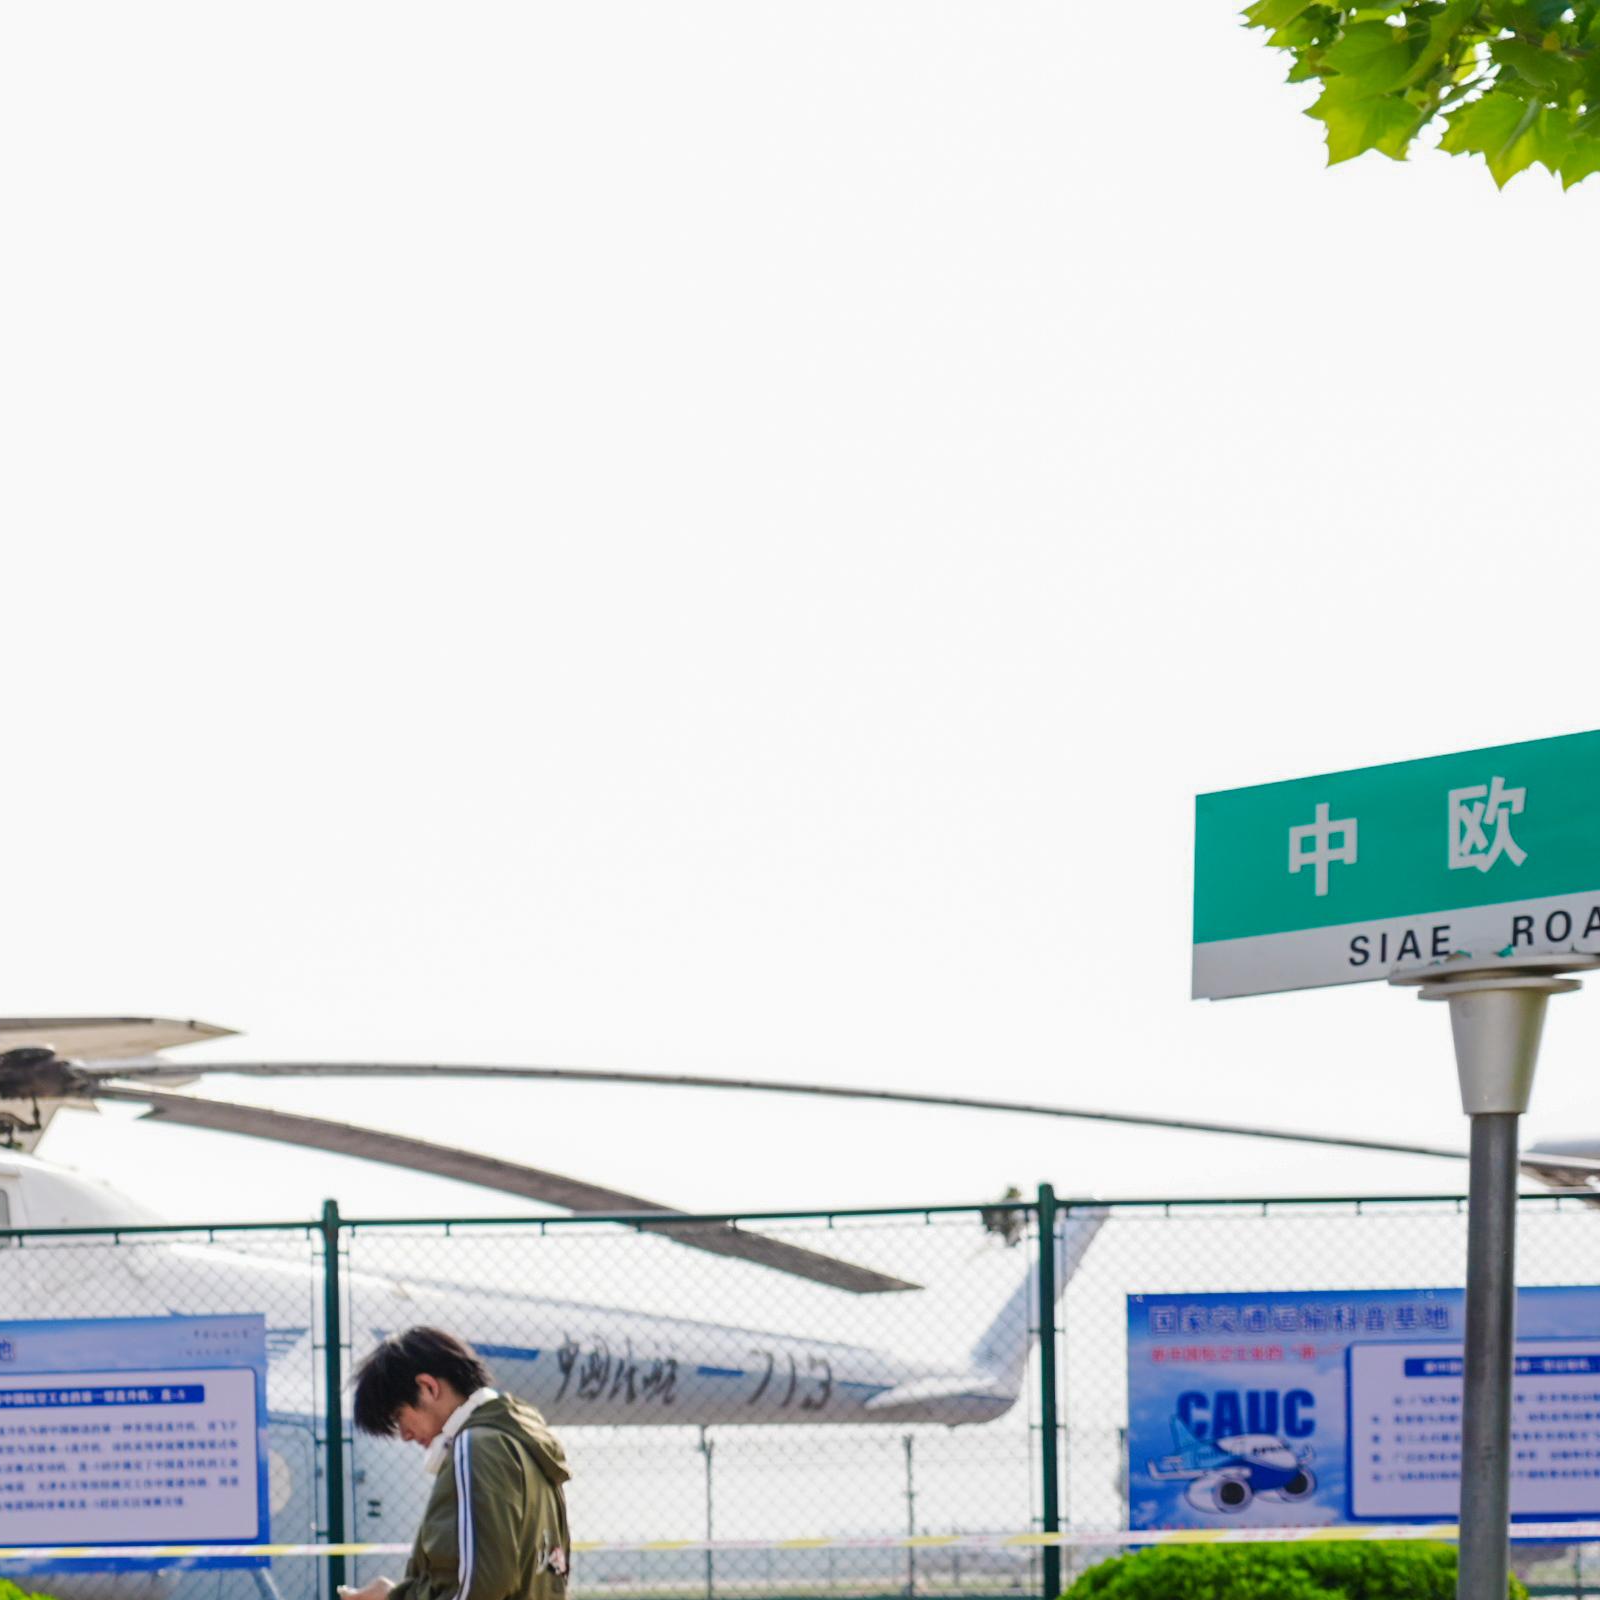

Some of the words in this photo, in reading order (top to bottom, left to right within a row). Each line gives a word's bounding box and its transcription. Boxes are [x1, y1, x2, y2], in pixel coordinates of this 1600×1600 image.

[1289, 776, 1528, 897] 中欧
[1349, 925, 1453, 967] SIAE
[1150, 1304, 1450, 1335] 国家交通运输科普基地
[1177, 1389, 1316, 1441] CAUC
